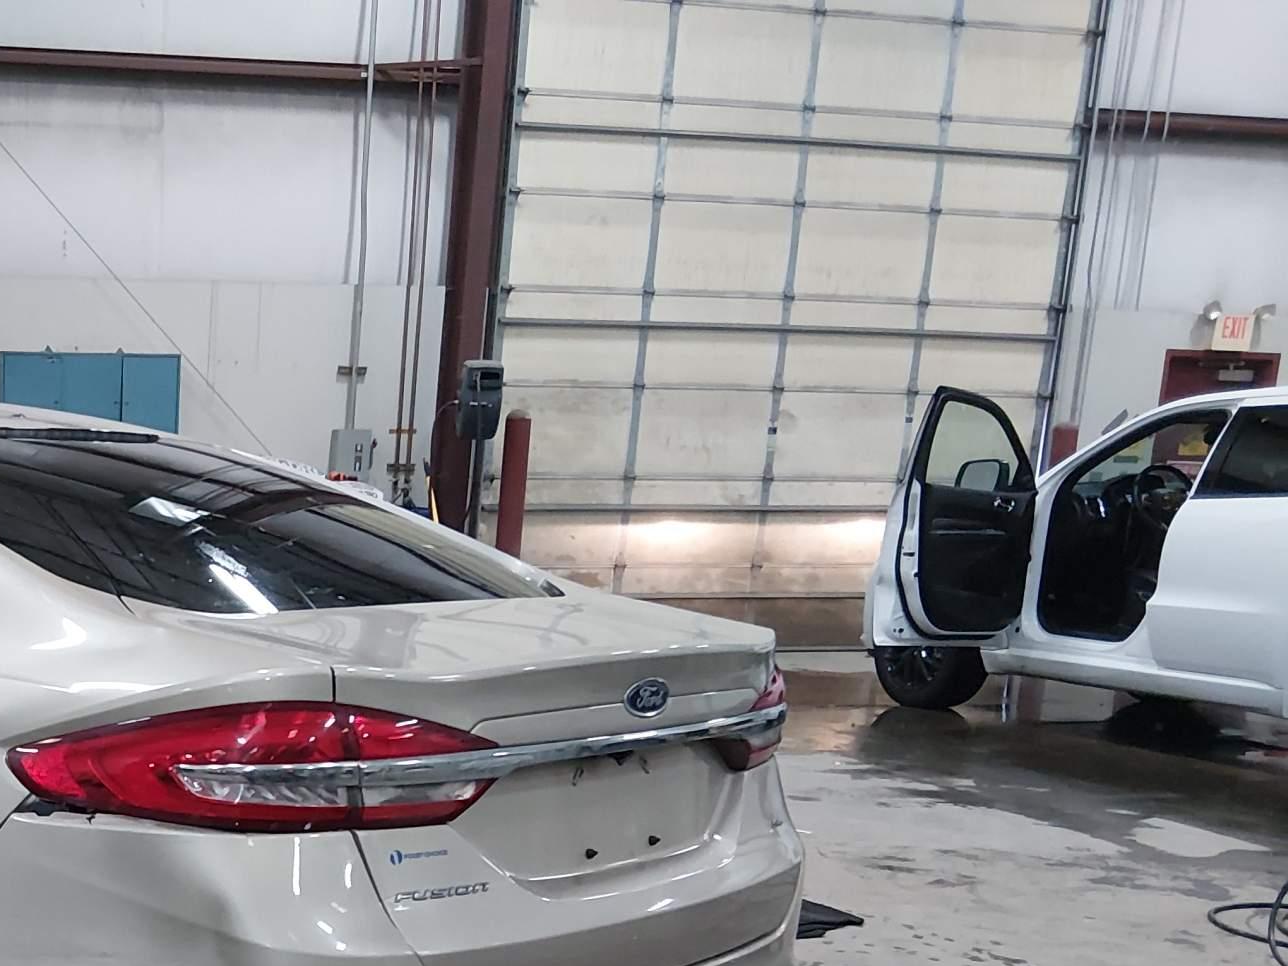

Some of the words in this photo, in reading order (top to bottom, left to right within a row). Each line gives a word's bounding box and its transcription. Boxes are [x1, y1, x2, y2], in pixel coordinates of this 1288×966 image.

[1222, 316, 1249, 338] EXIT
[636, 686, 664, 708] Ford
[394, 881, 490, 903] FUSION
